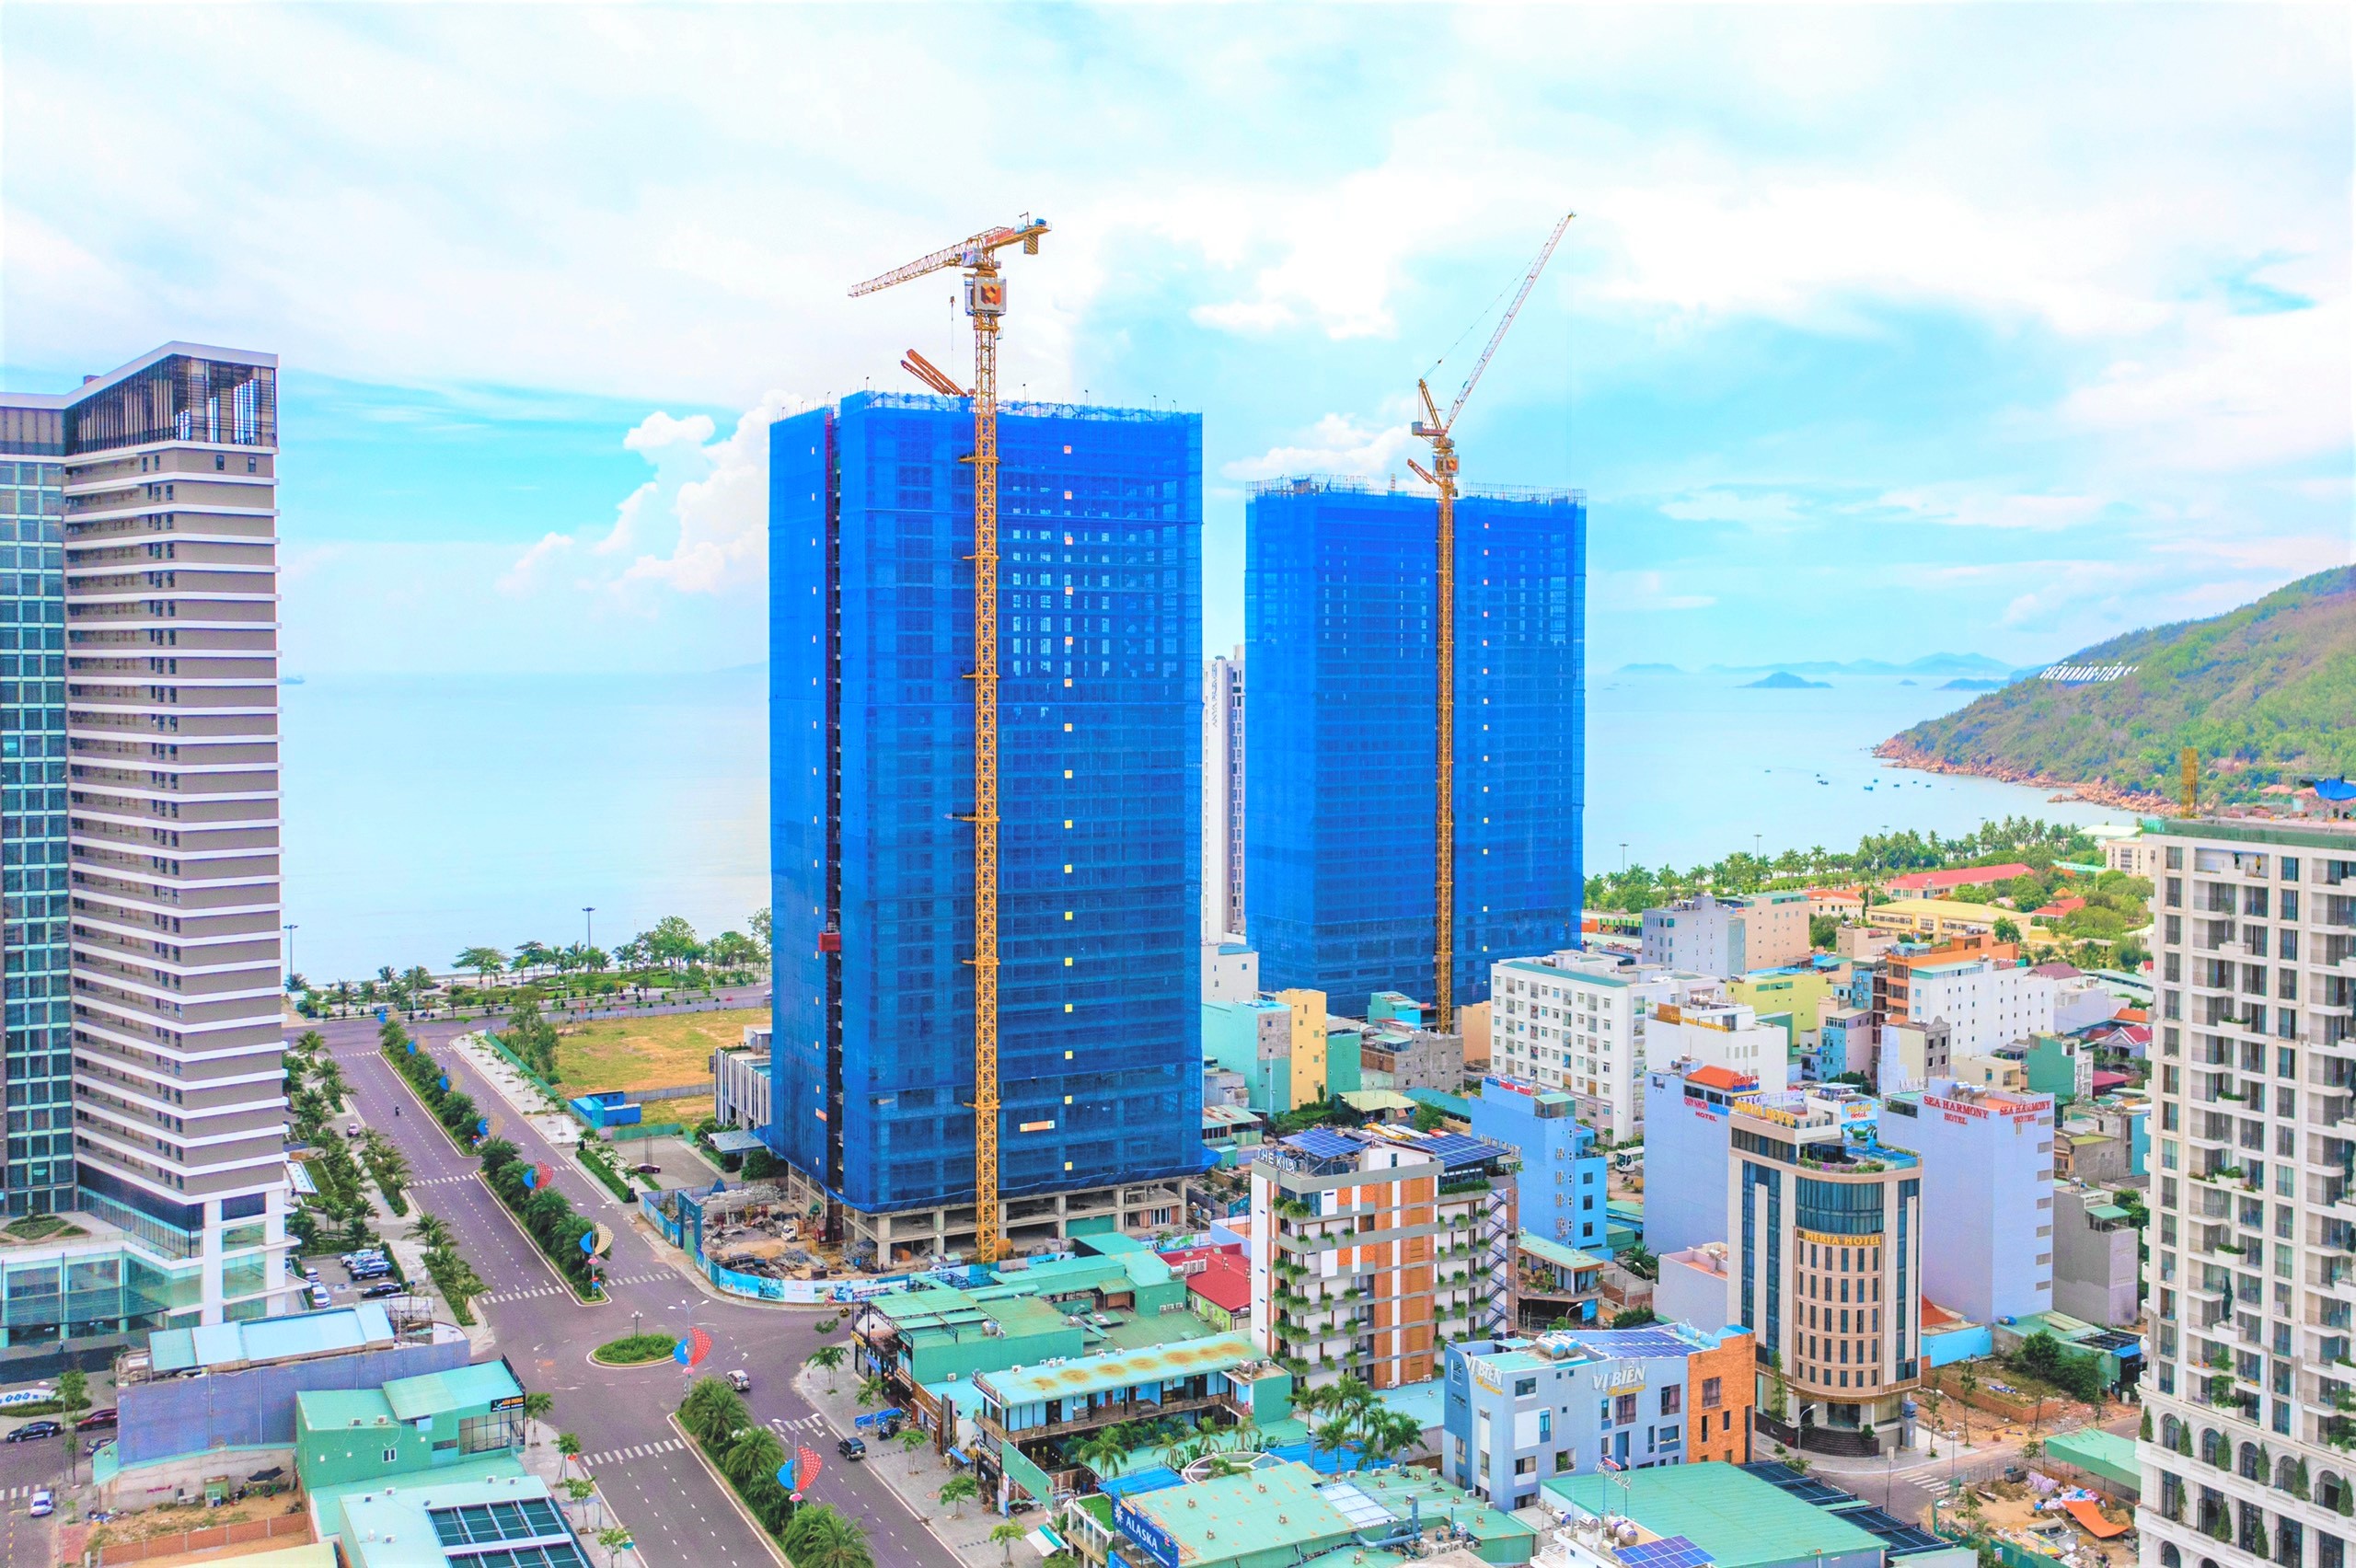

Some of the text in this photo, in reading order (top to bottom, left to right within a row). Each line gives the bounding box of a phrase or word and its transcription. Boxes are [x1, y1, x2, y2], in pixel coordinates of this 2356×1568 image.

[1923, 1096, 1989, 1119] SEA HARMONY
[2000, 1101, 2050, 1115] SEA HARMONY
[1695, 1112, 1717, 1122] HOTEL
[1944, 1113, 1968, 1124] HOTEL
[2014, 1114, 2036, 1124] HOTEL
[1257, 1147, 1274, 1164] THE
[1805, 1231, 1881, 1245] MERIA HOTEL
[1593, 1373, 1609, 1391] VỊ
[1611, 1361, 1646, 1387] BIỂN
[1126, 1516, 1159, 1551] ALASKA
